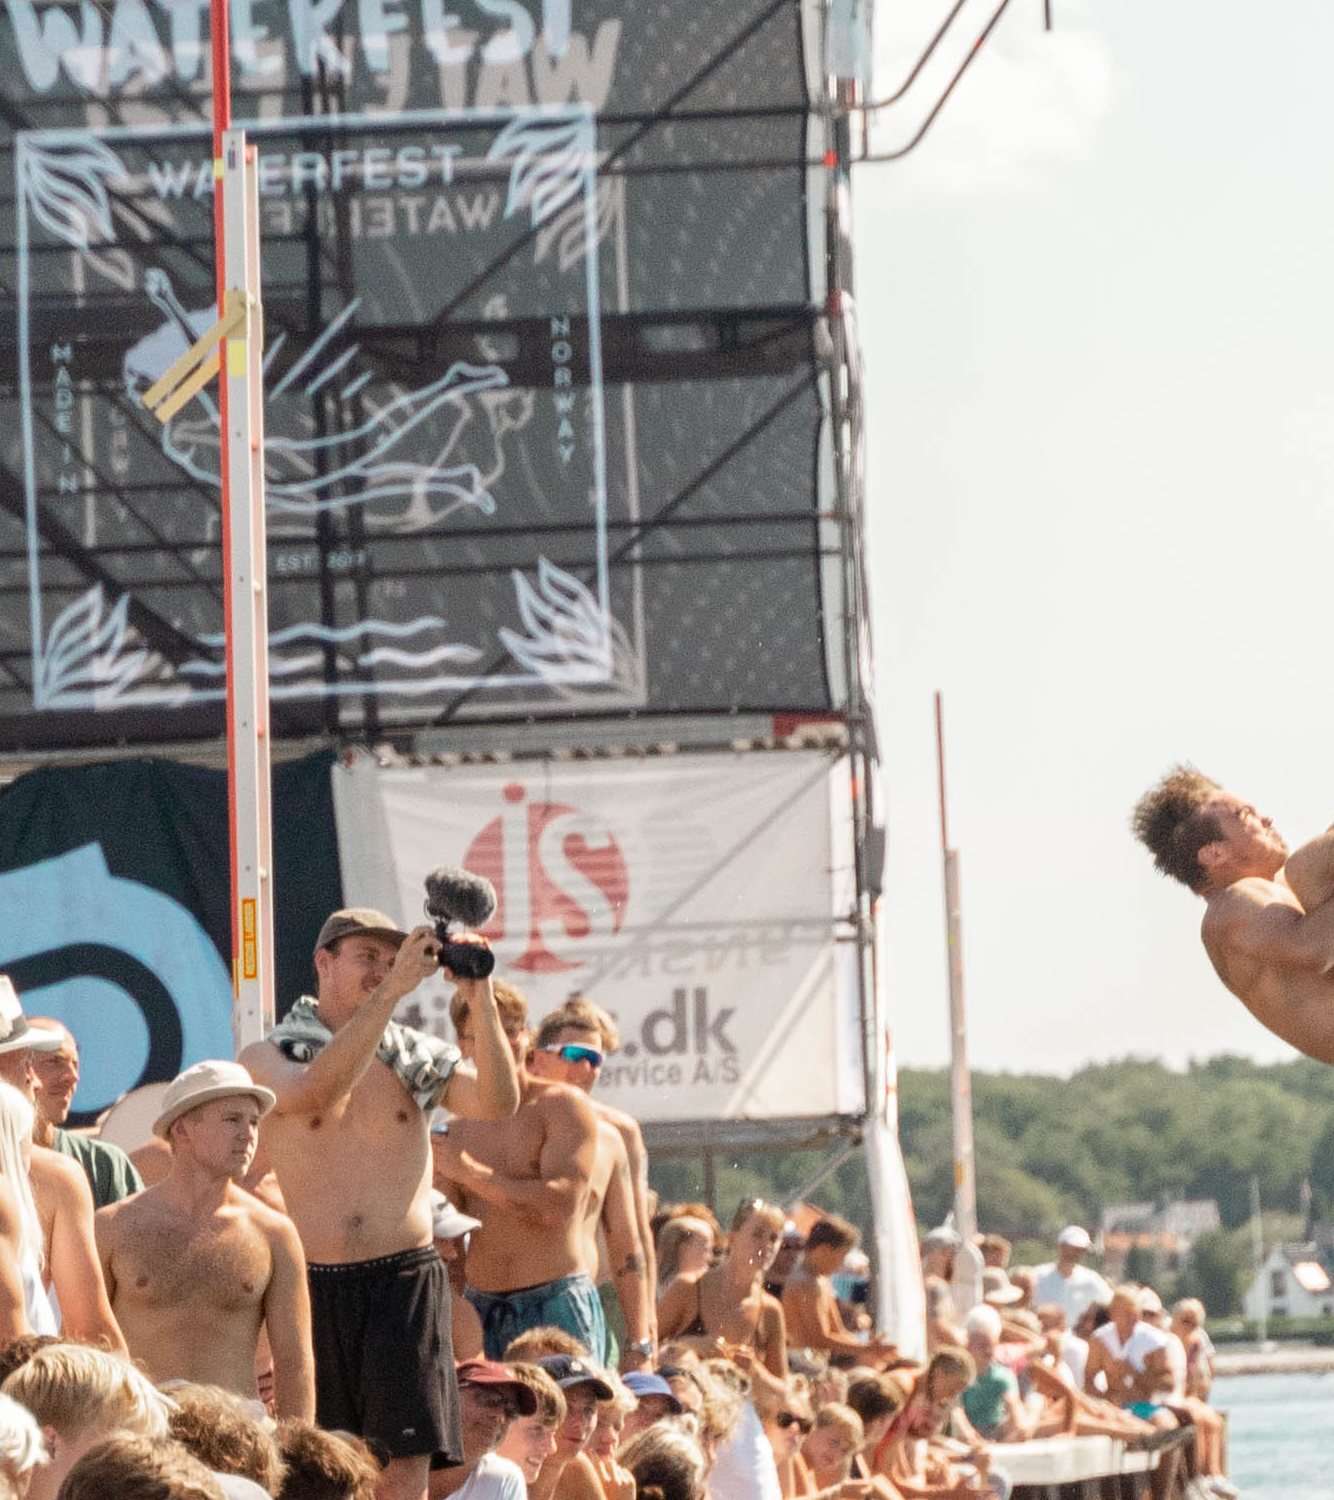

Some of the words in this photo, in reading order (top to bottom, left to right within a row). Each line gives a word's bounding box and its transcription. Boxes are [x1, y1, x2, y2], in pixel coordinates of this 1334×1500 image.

[148, 143, 463, 201] WAERFEST
[51, 342, 73, 434] MADE
[551, 316, 577, 461] NORWAY
[59, 444, 78, 494] IN
[597, 1056, 683, 1088] ervice
